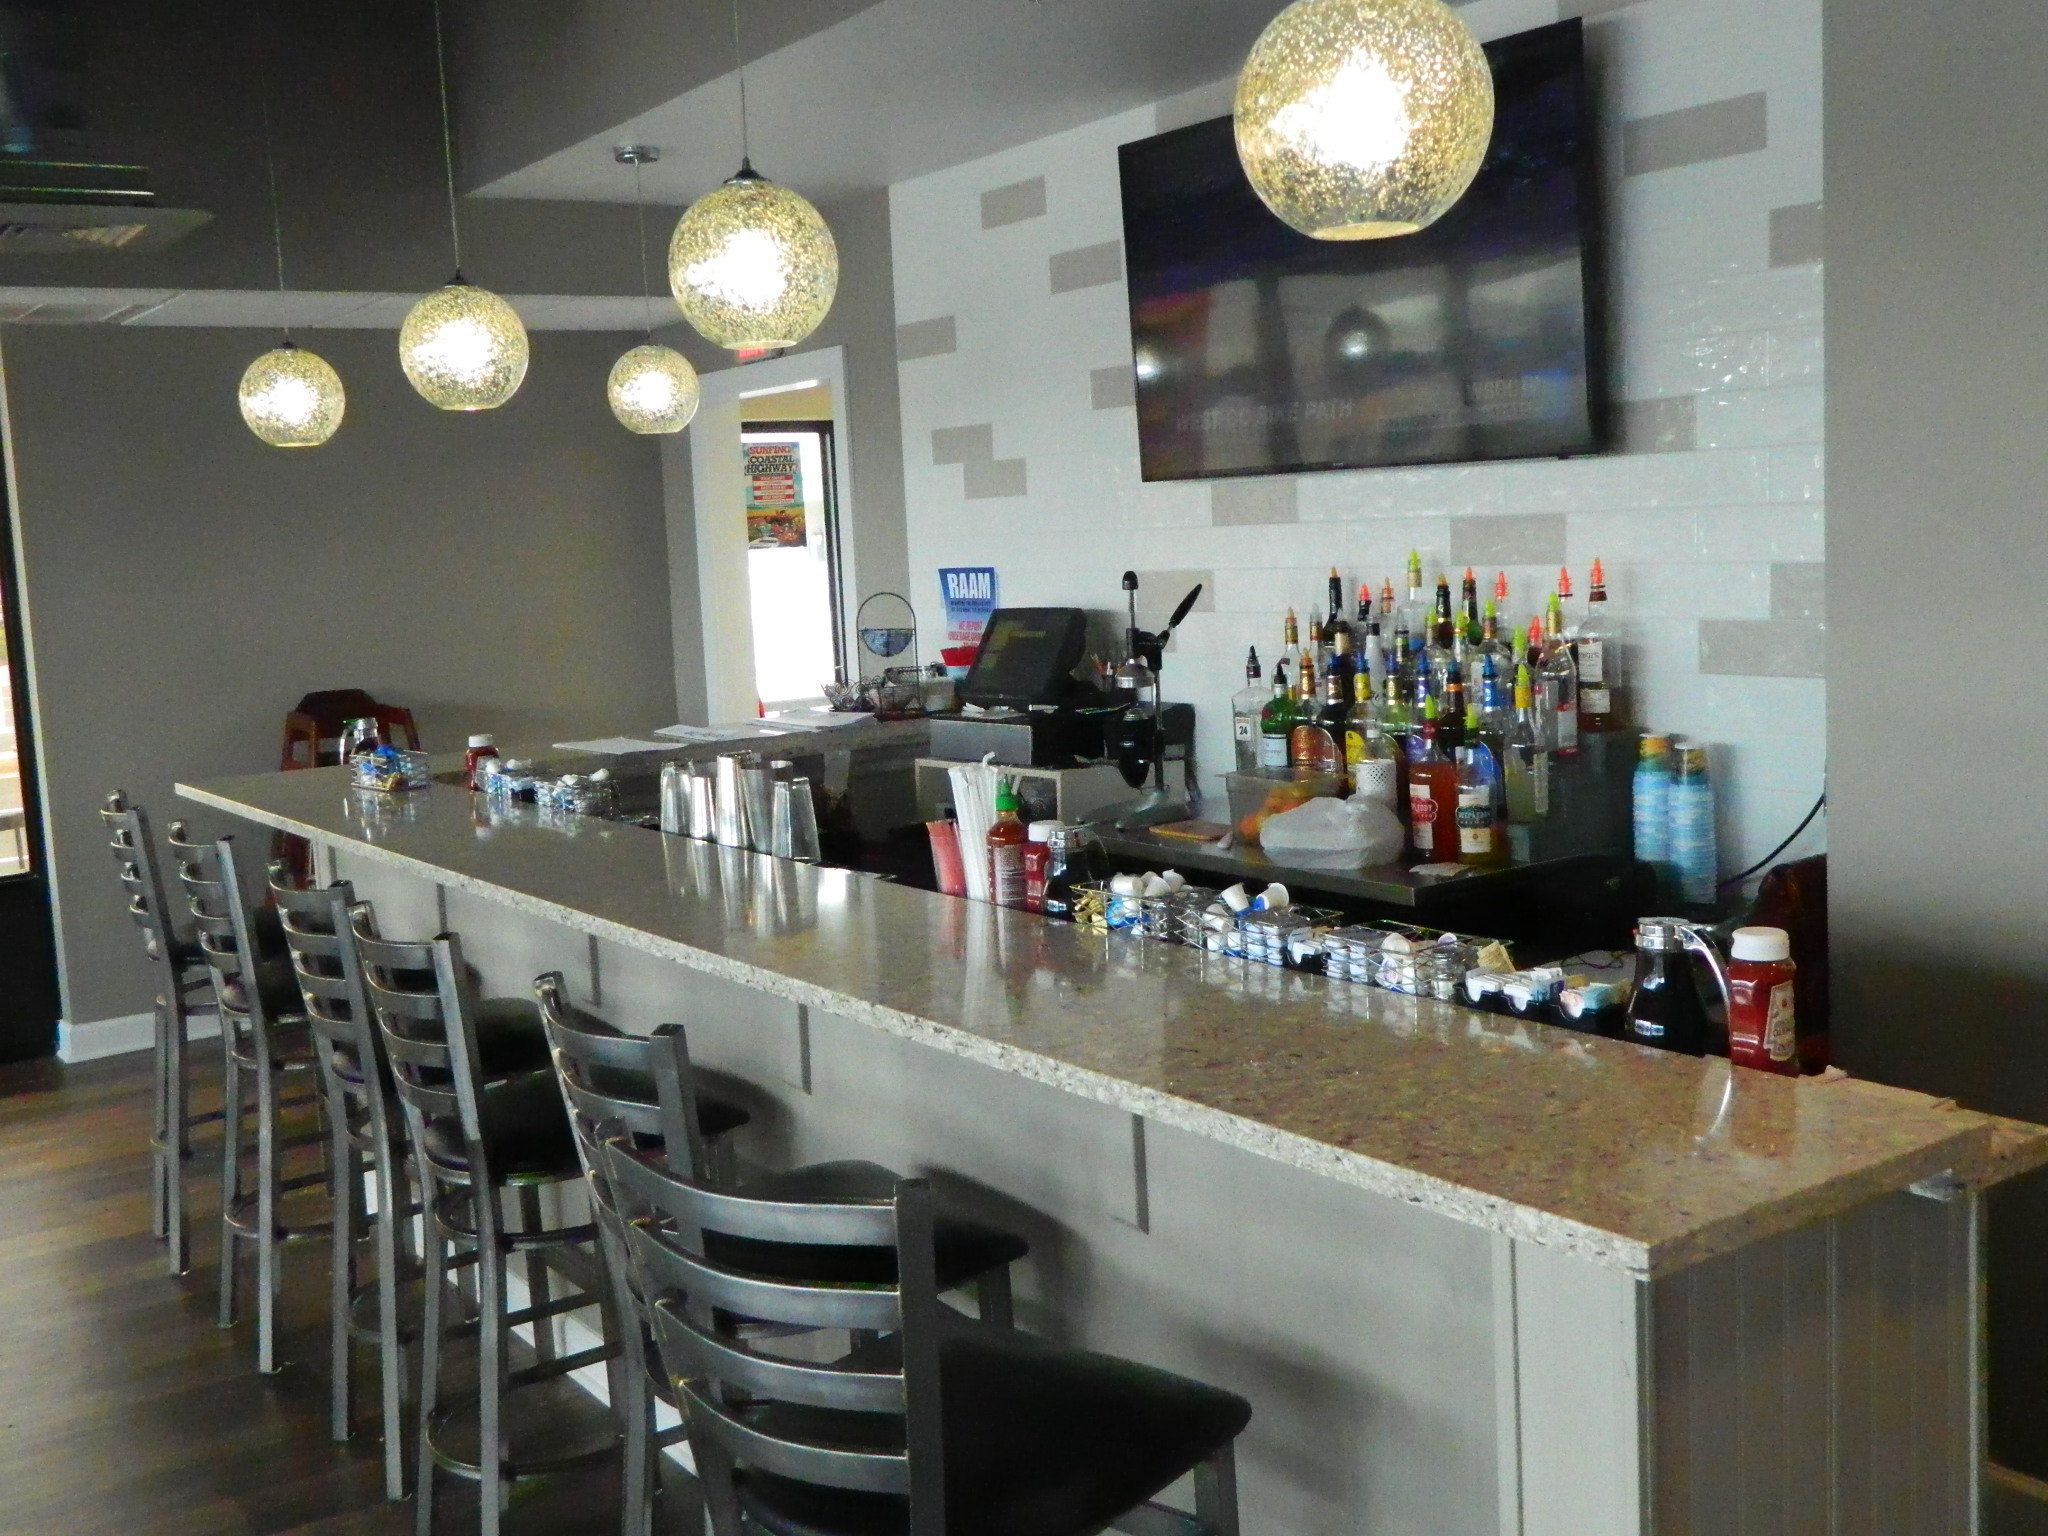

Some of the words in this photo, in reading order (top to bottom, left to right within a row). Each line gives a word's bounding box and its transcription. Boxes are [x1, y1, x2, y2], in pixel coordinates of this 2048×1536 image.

[749, 455, 794, 464] COASTAL
[746, 463, 793, 473] HIGHWAY
[947, 573, 990, 598] RAAM
